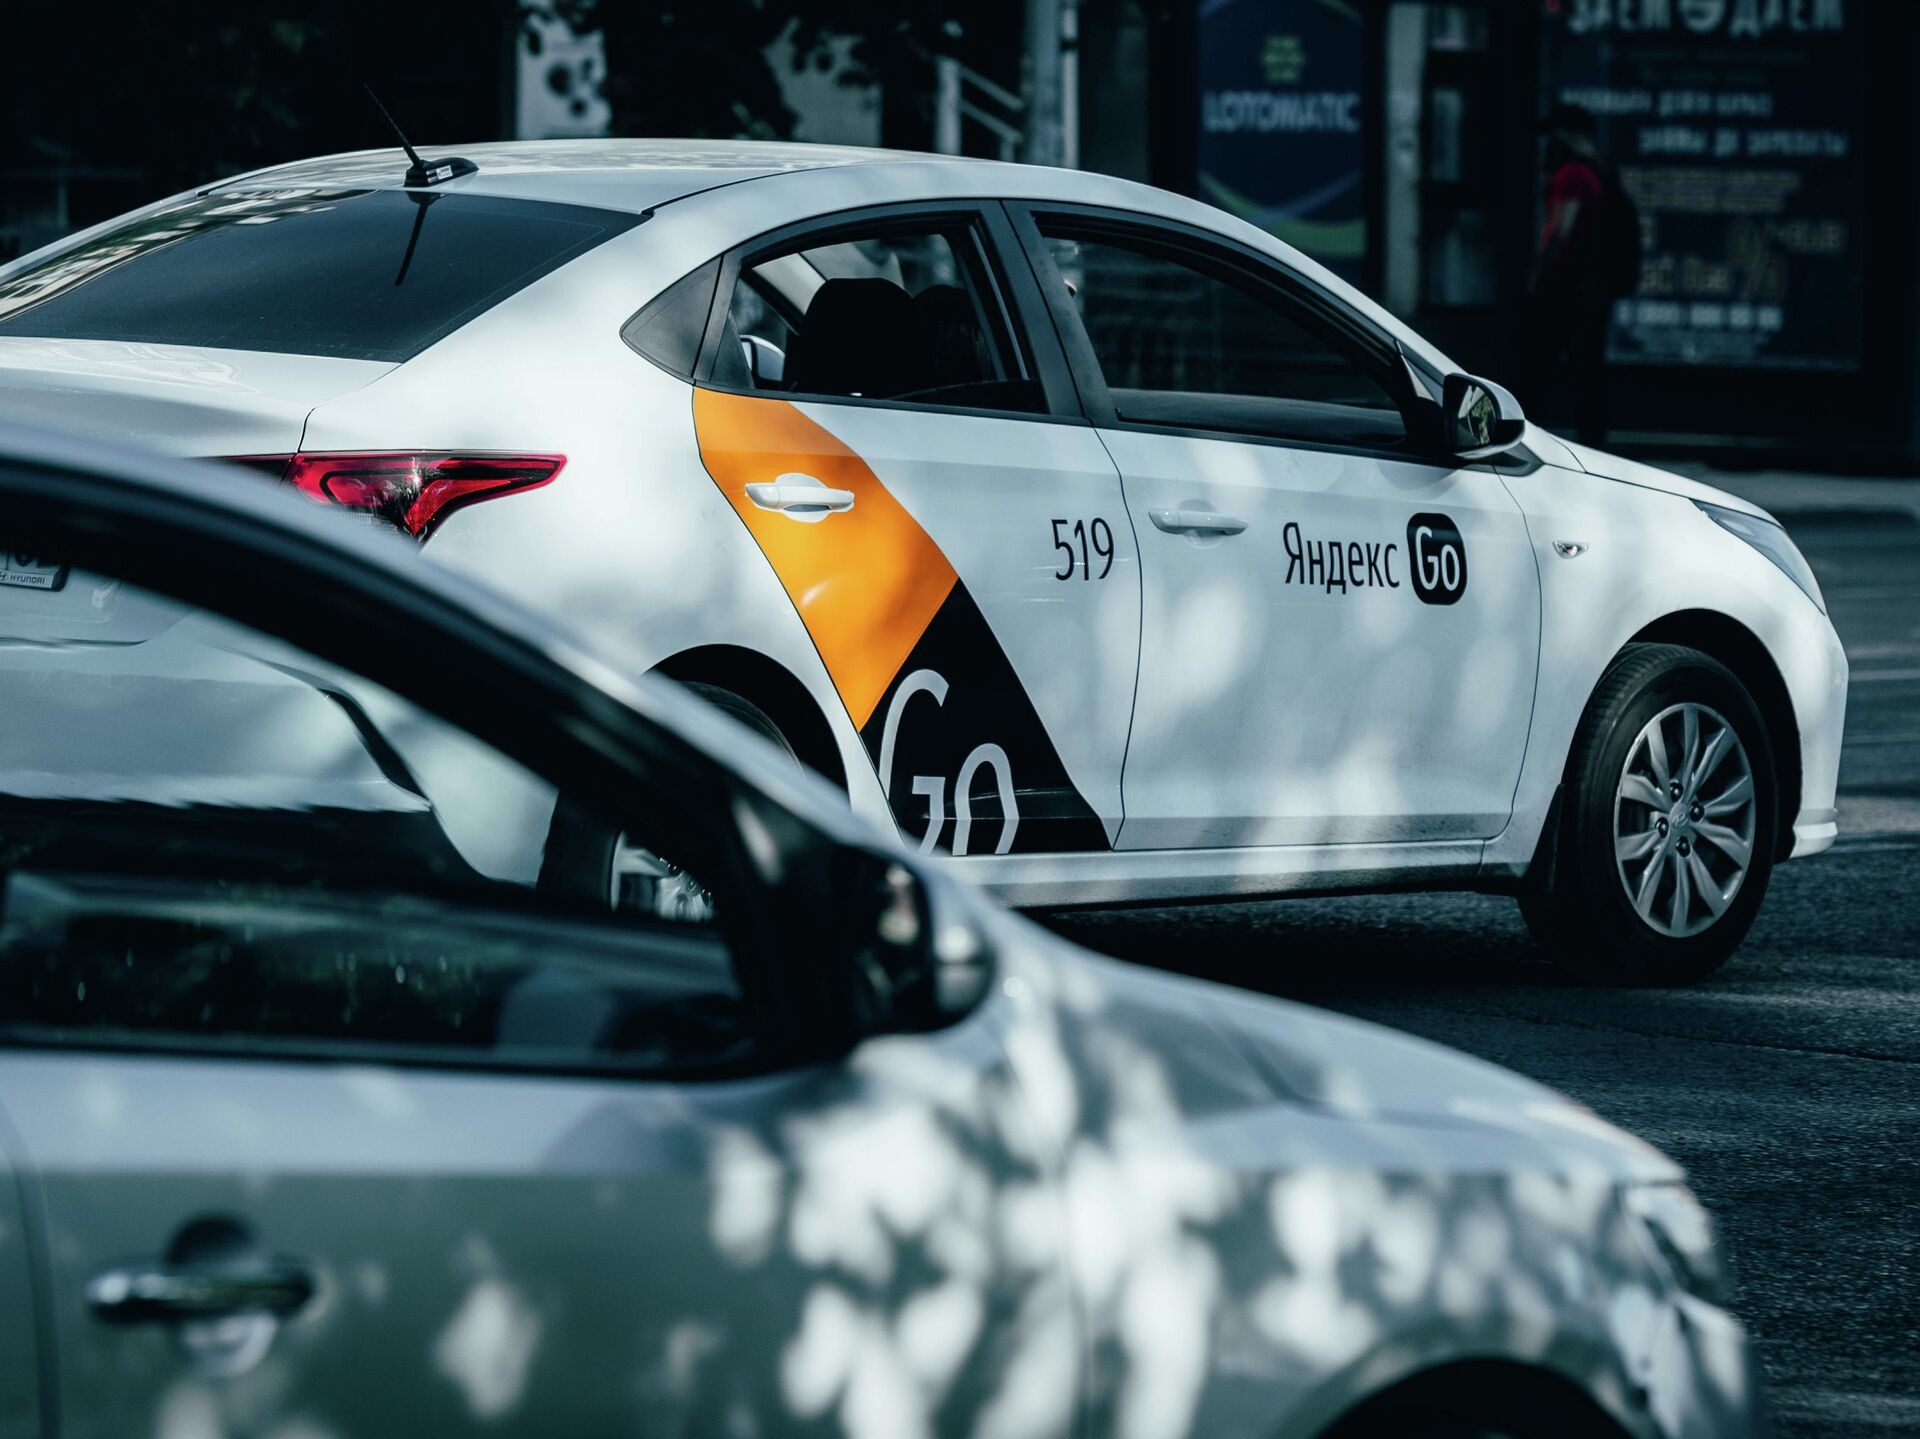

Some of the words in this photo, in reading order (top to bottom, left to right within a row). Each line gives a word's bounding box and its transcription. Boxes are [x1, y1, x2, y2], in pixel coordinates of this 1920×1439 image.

[1203, 90, 1360, 131] LOTOMATIC
[1051, 517, 1114, 581] 519
[1282, 521, 1400, 594] Яндекс
[1415, 526, 1461, 591] Go
[10, 574, 46, 585] HYUNDAI
